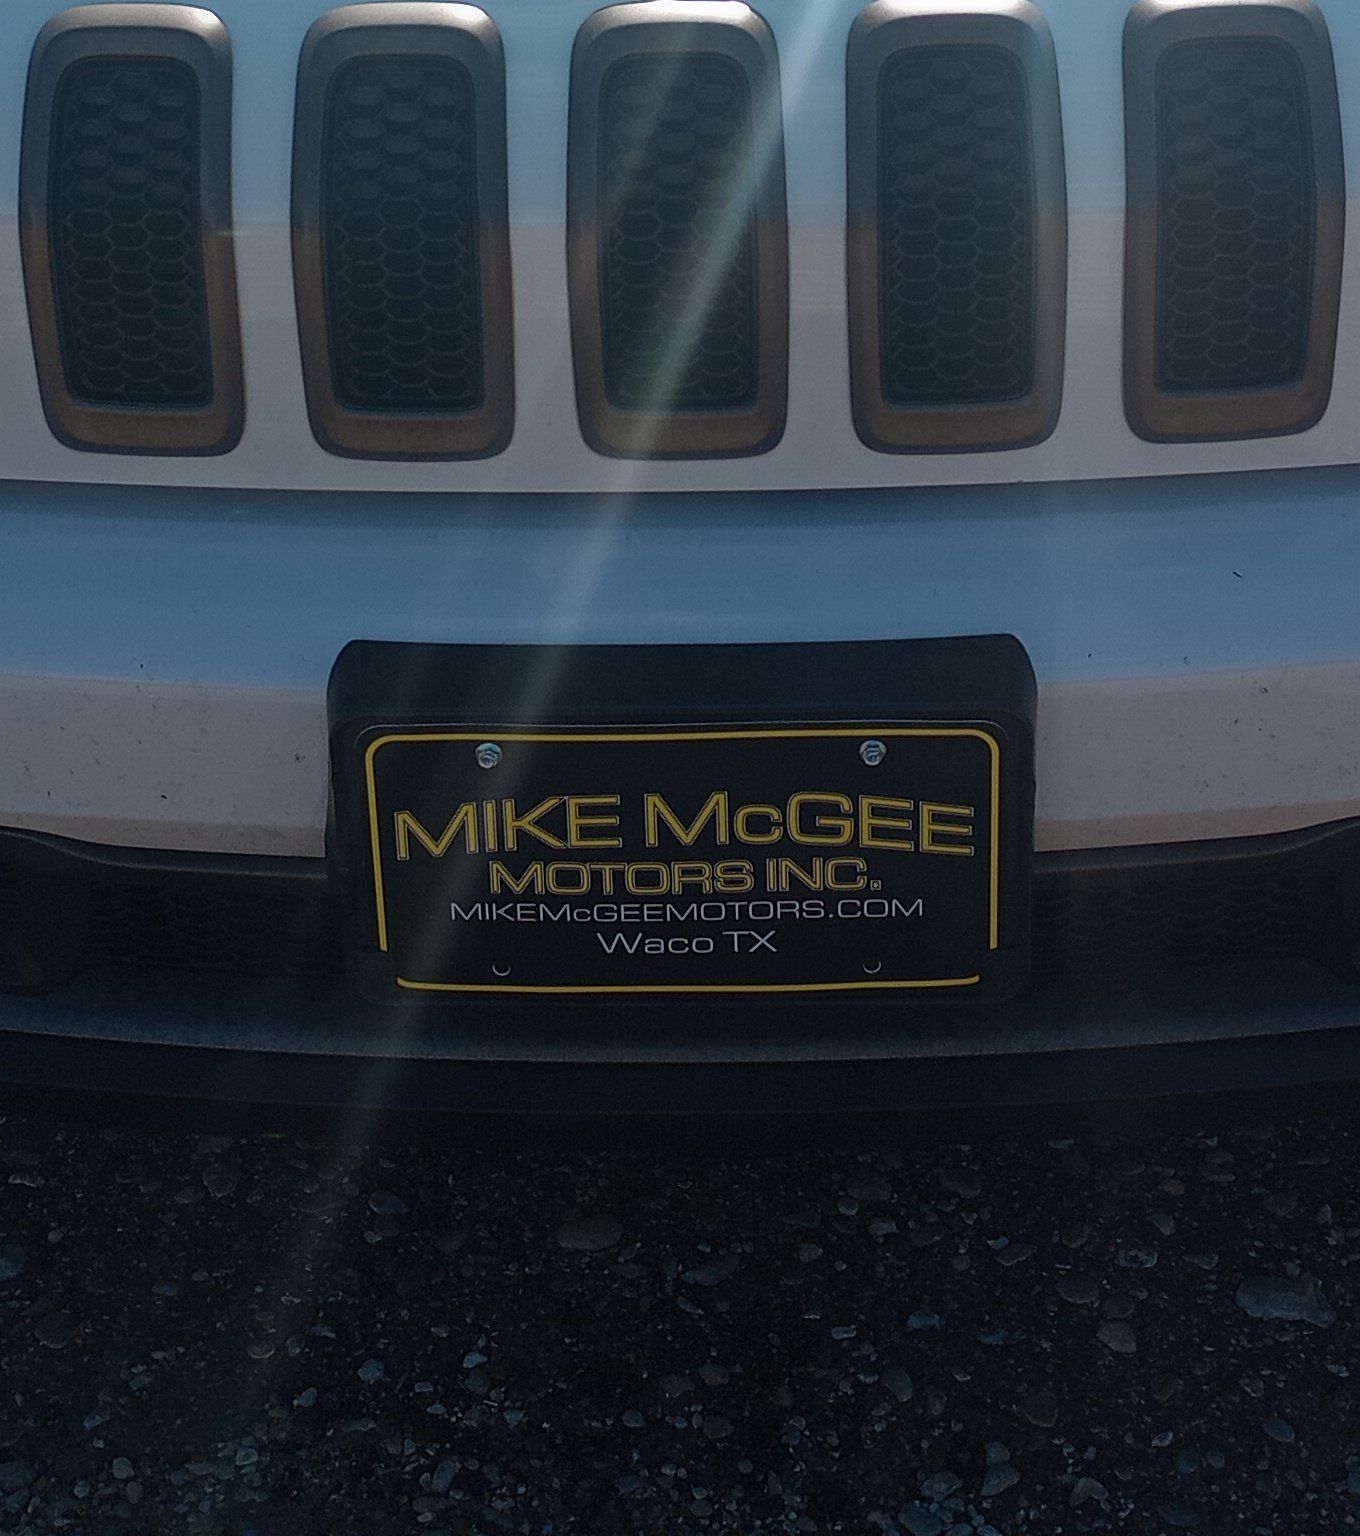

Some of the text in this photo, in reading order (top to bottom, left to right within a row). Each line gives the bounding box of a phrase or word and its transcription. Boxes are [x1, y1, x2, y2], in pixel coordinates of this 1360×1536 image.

[394, 791, 975, 861] MIKE McGEE
[490, 856, 882, 895] MOTORS INC.
[450, 899, 924, 923] MIKEMcGEEMOTORS.COM
[596, 930, 778, 954] Waco TX
